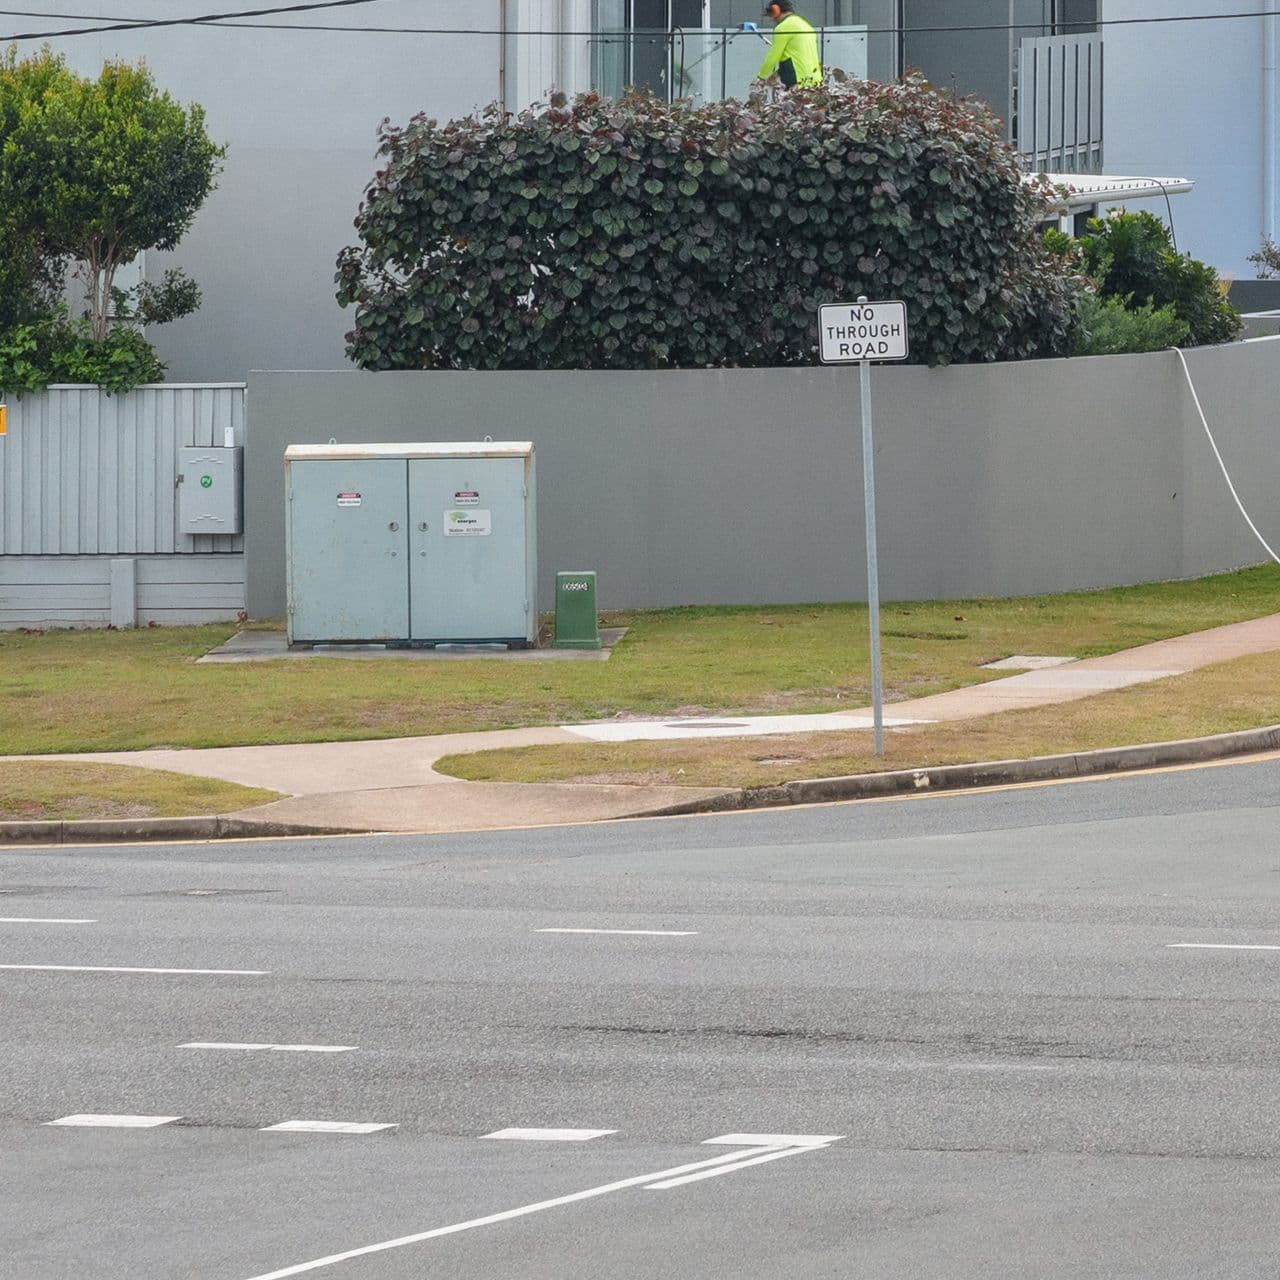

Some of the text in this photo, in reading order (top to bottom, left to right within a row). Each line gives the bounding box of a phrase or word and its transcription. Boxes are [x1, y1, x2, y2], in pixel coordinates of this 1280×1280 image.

[850, 308, 874, 322] NO
[826, 324, 900, 339] THROUGH
[840, 341, 889, 356] ROAD
